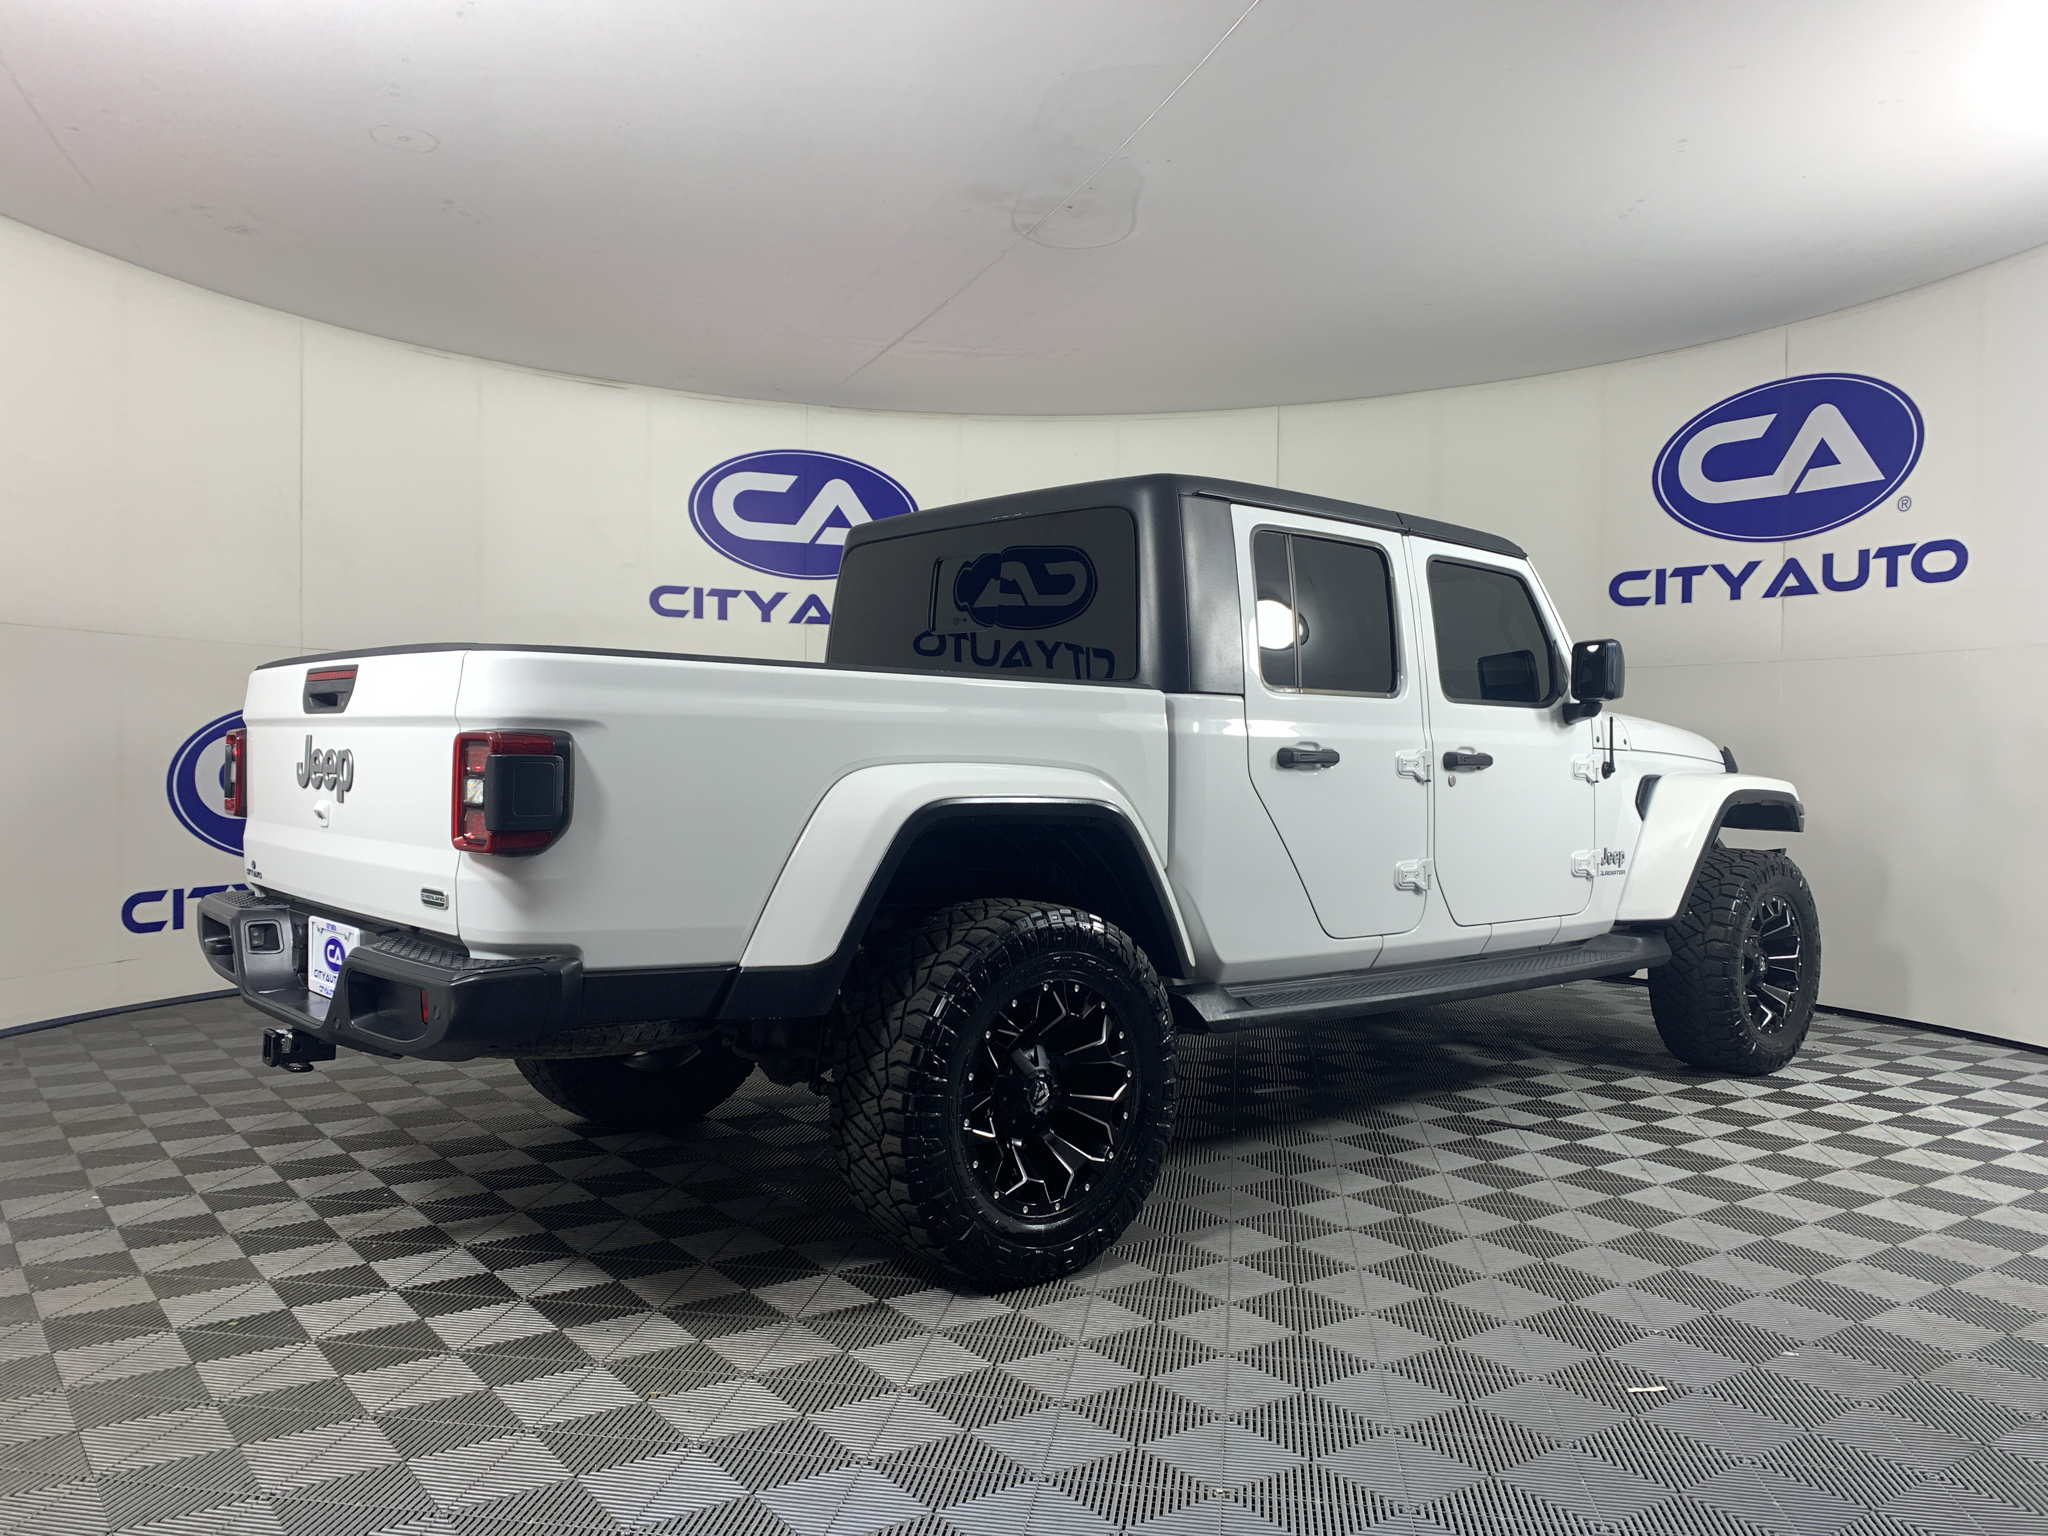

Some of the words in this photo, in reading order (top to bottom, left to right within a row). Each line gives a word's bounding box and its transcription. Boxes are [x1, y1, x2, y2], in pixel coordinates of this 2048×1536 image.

[1677, 403, 1886, 504] CA
[712, 471, 874, 545] CA
[296, 734, 354, 804] Jeep
[1601, 847, 1625, 868] Jeep
[121, 883, 249, 934] CIT
[326, 944, 343, 966] CA
